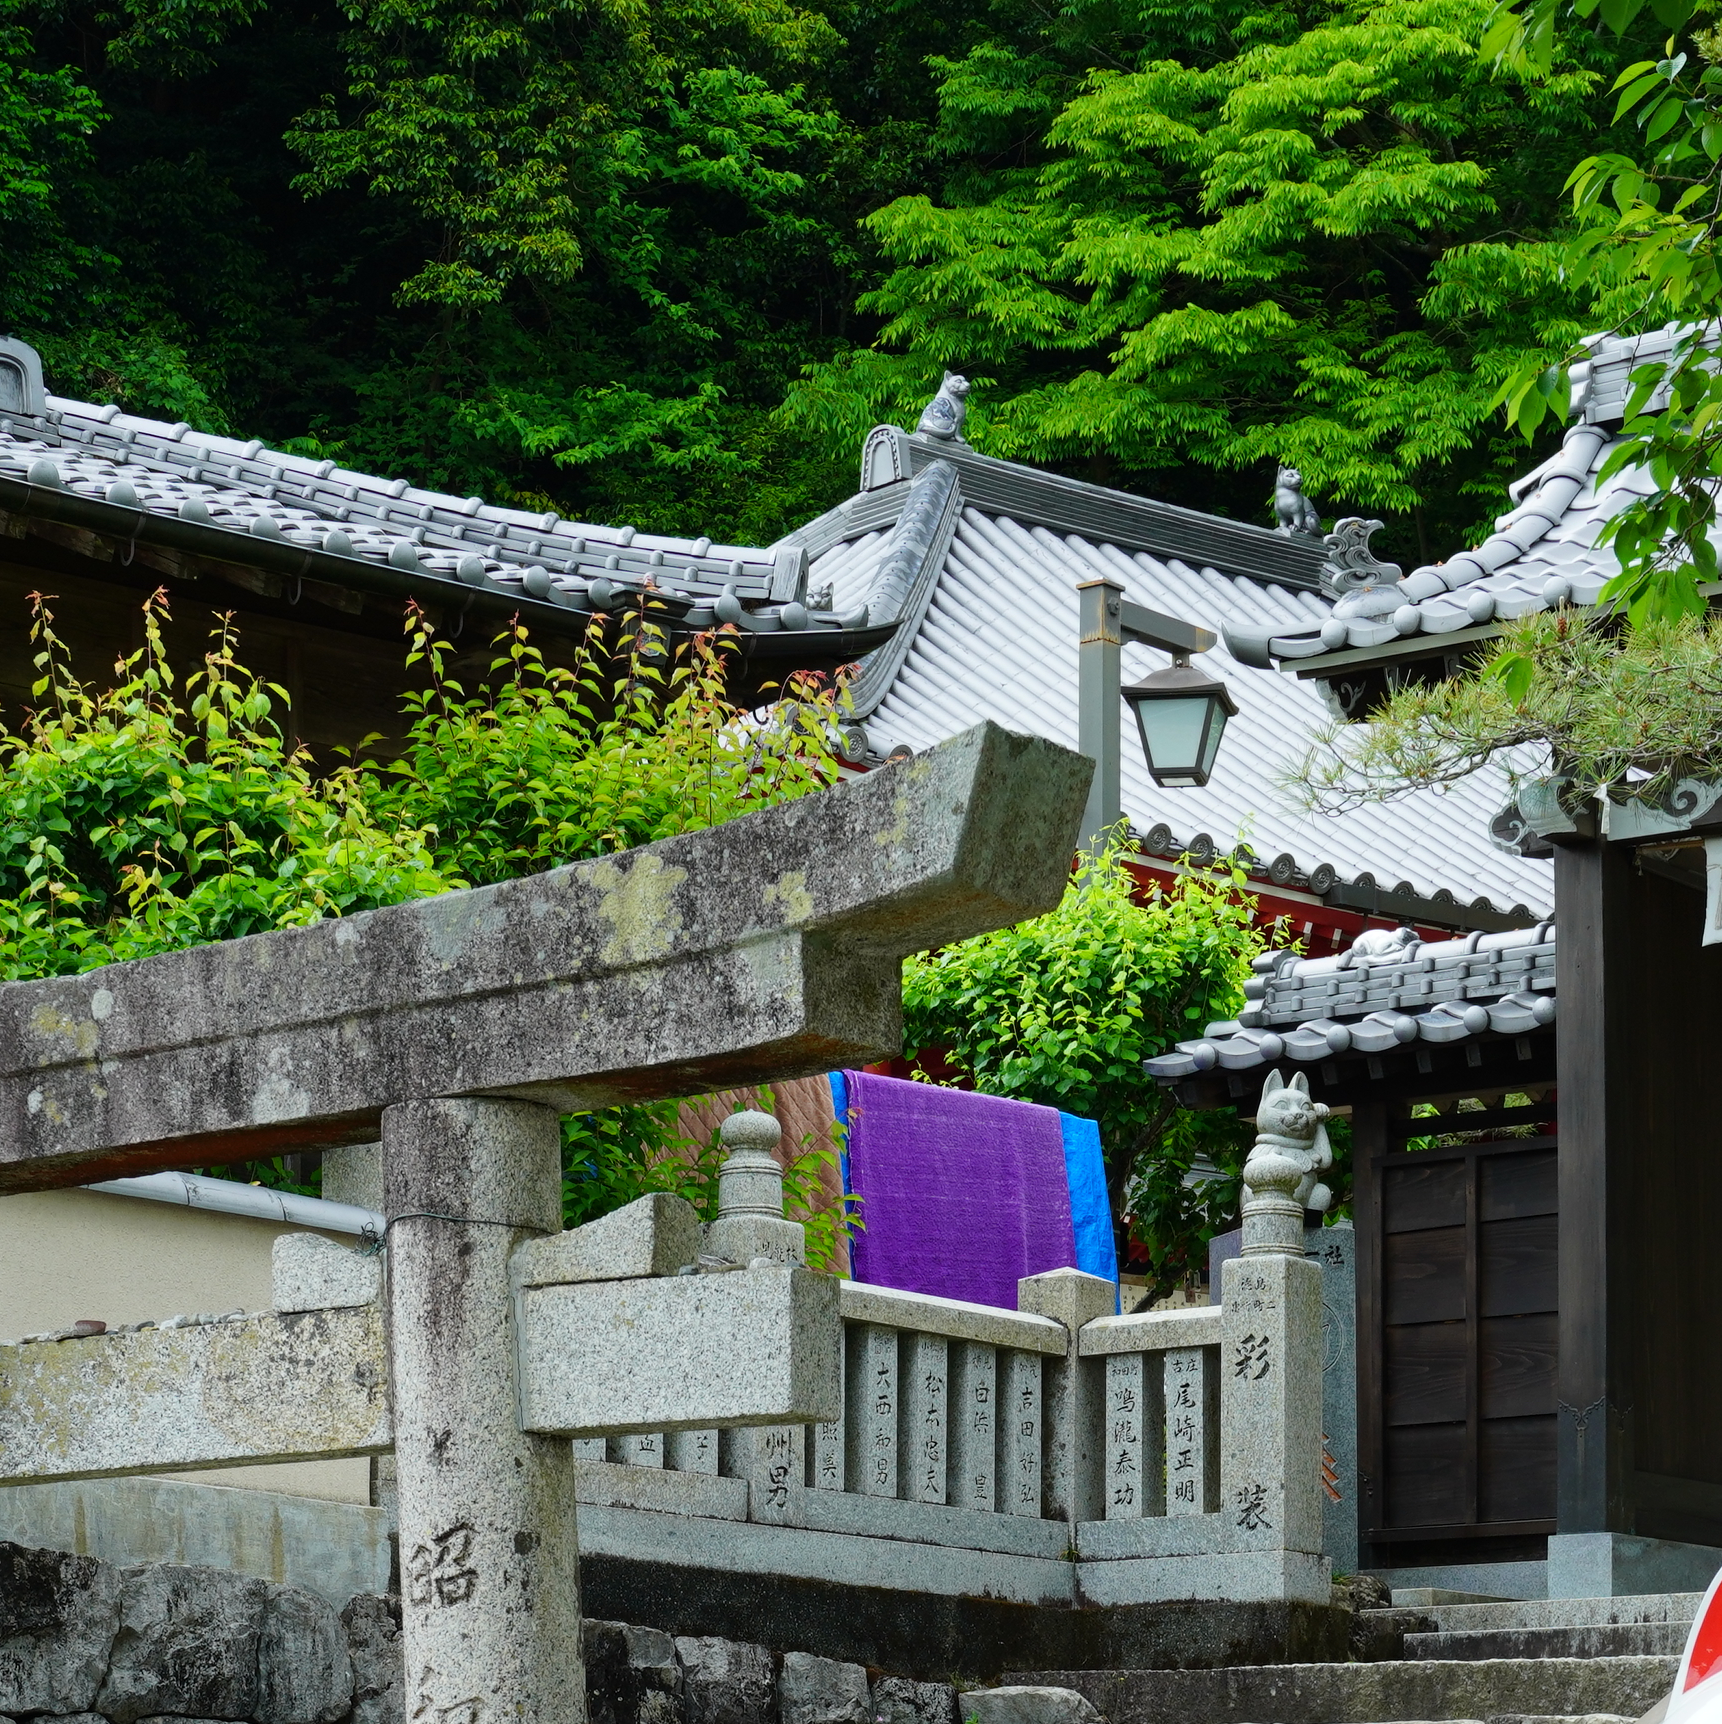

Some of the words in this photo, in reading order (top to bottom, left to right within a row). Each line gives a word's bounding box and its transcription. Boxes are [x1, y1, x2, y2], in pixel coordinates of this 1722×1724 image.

[1174, 1382, 1197, 1503] 尾崎正明
[1234, 1333, 1273, 1531] 彩装
